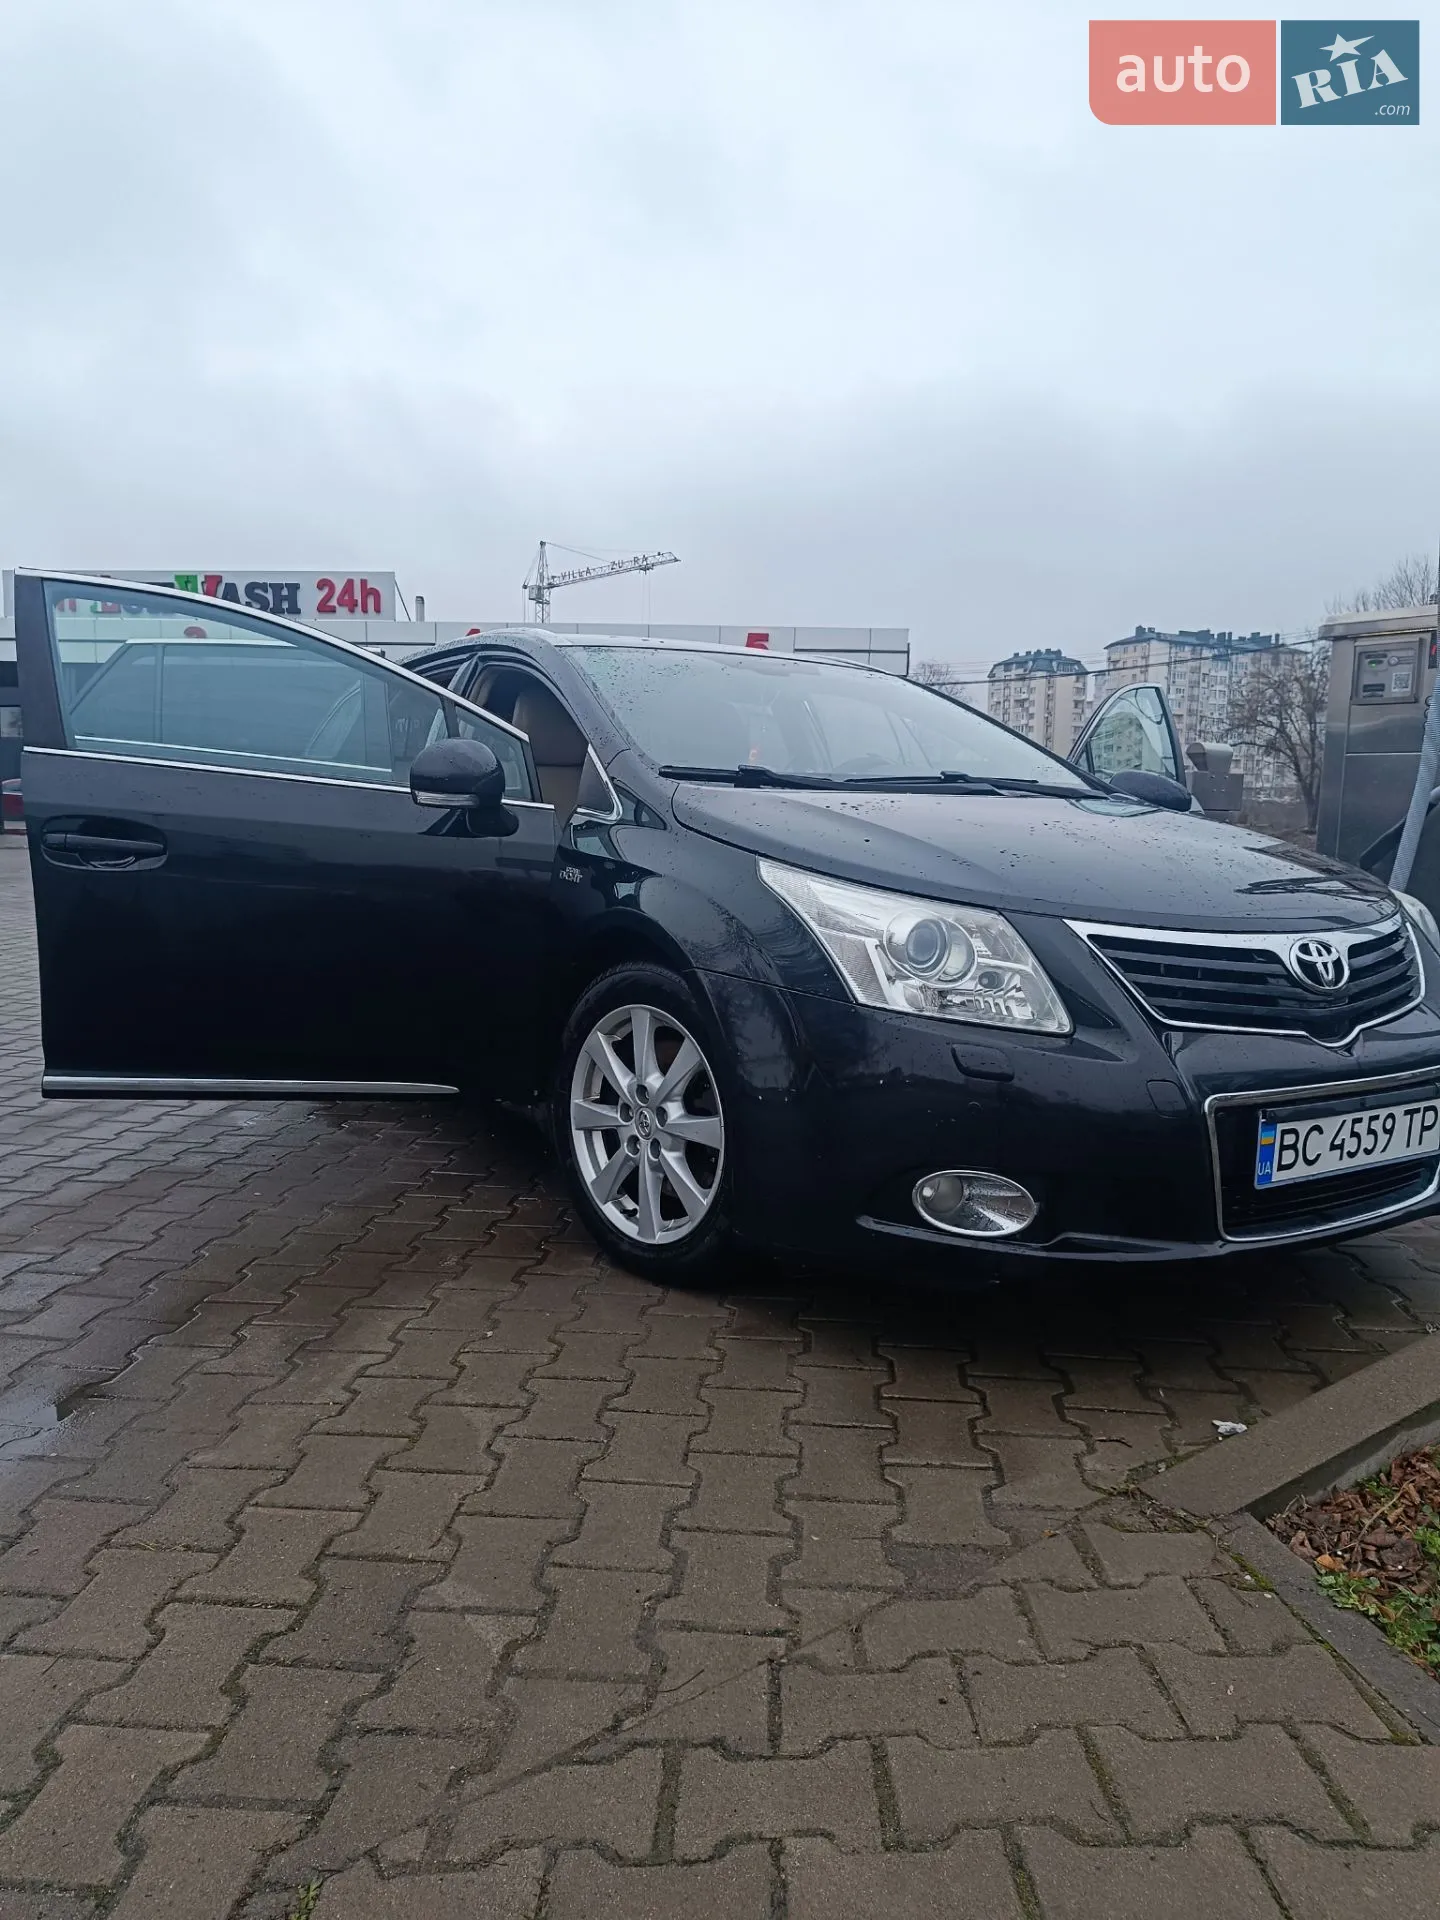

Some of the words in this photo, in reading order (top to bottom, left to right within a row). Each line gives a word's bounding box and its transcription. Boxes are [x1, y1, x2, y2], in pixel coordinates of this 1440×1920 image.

[316, 577, 382, 614] 24h
[1276, 1124, 1324, 1172] BC
[1329, 1112, 1396, 1161] 4559
[1403, 1104, 1439, 1148] TP
[1257, 1162, 1272, 1176] UA
